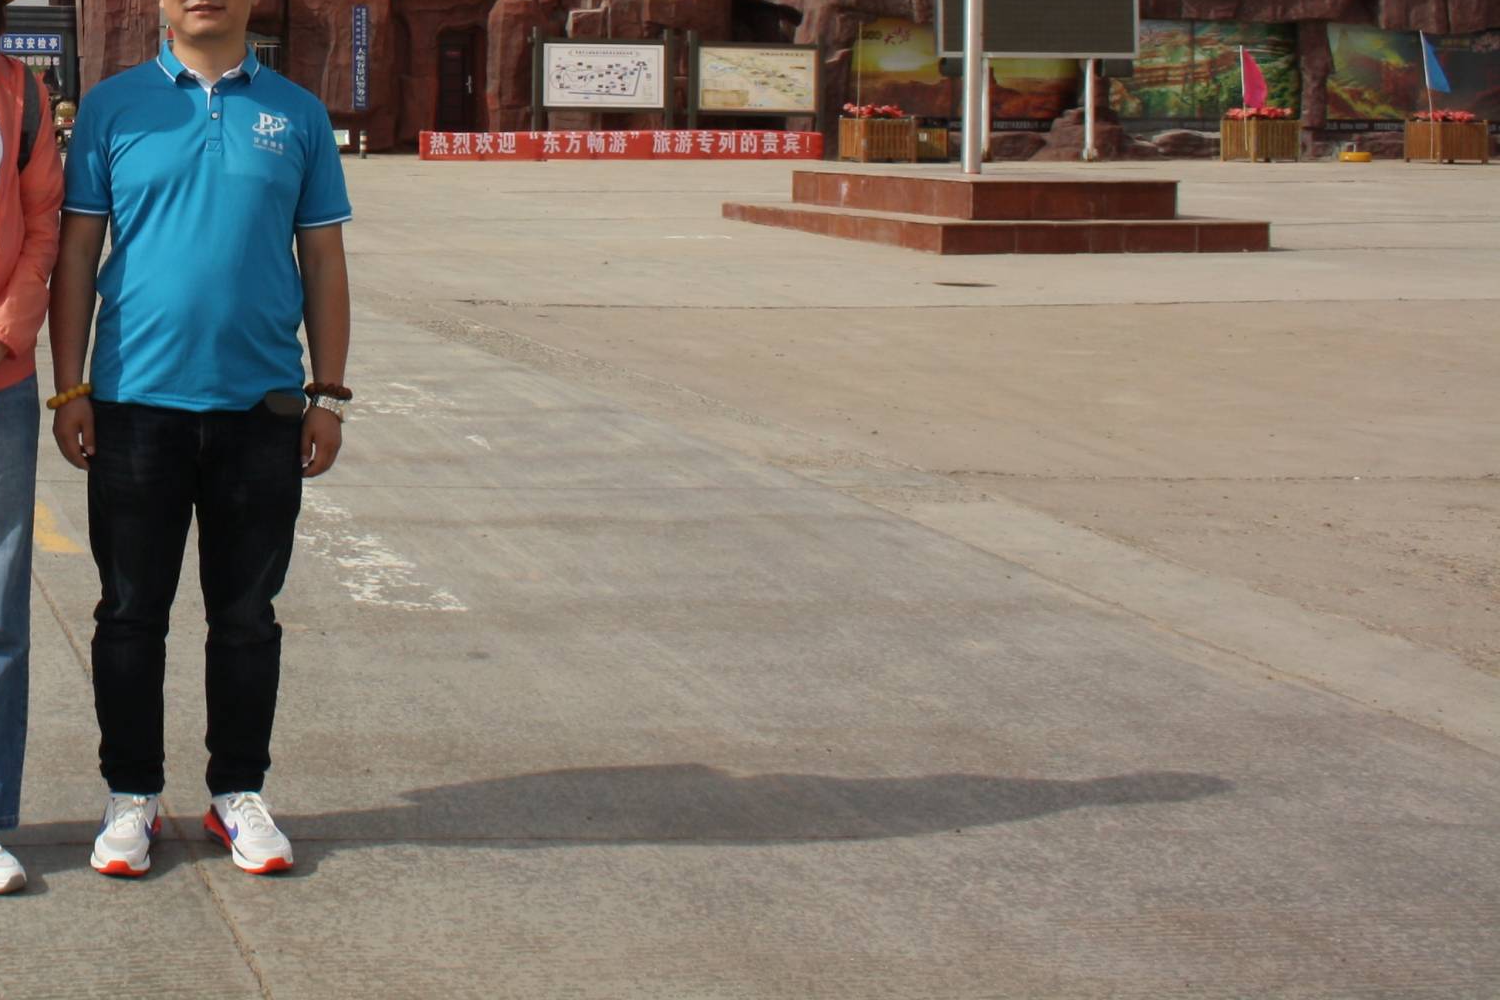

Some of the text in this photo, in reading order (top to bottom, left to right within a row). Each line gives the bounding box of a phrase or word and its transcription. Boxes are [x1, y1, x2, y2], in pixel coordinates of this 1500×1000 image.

[3, 36, 58, 50] 治安安检亭
